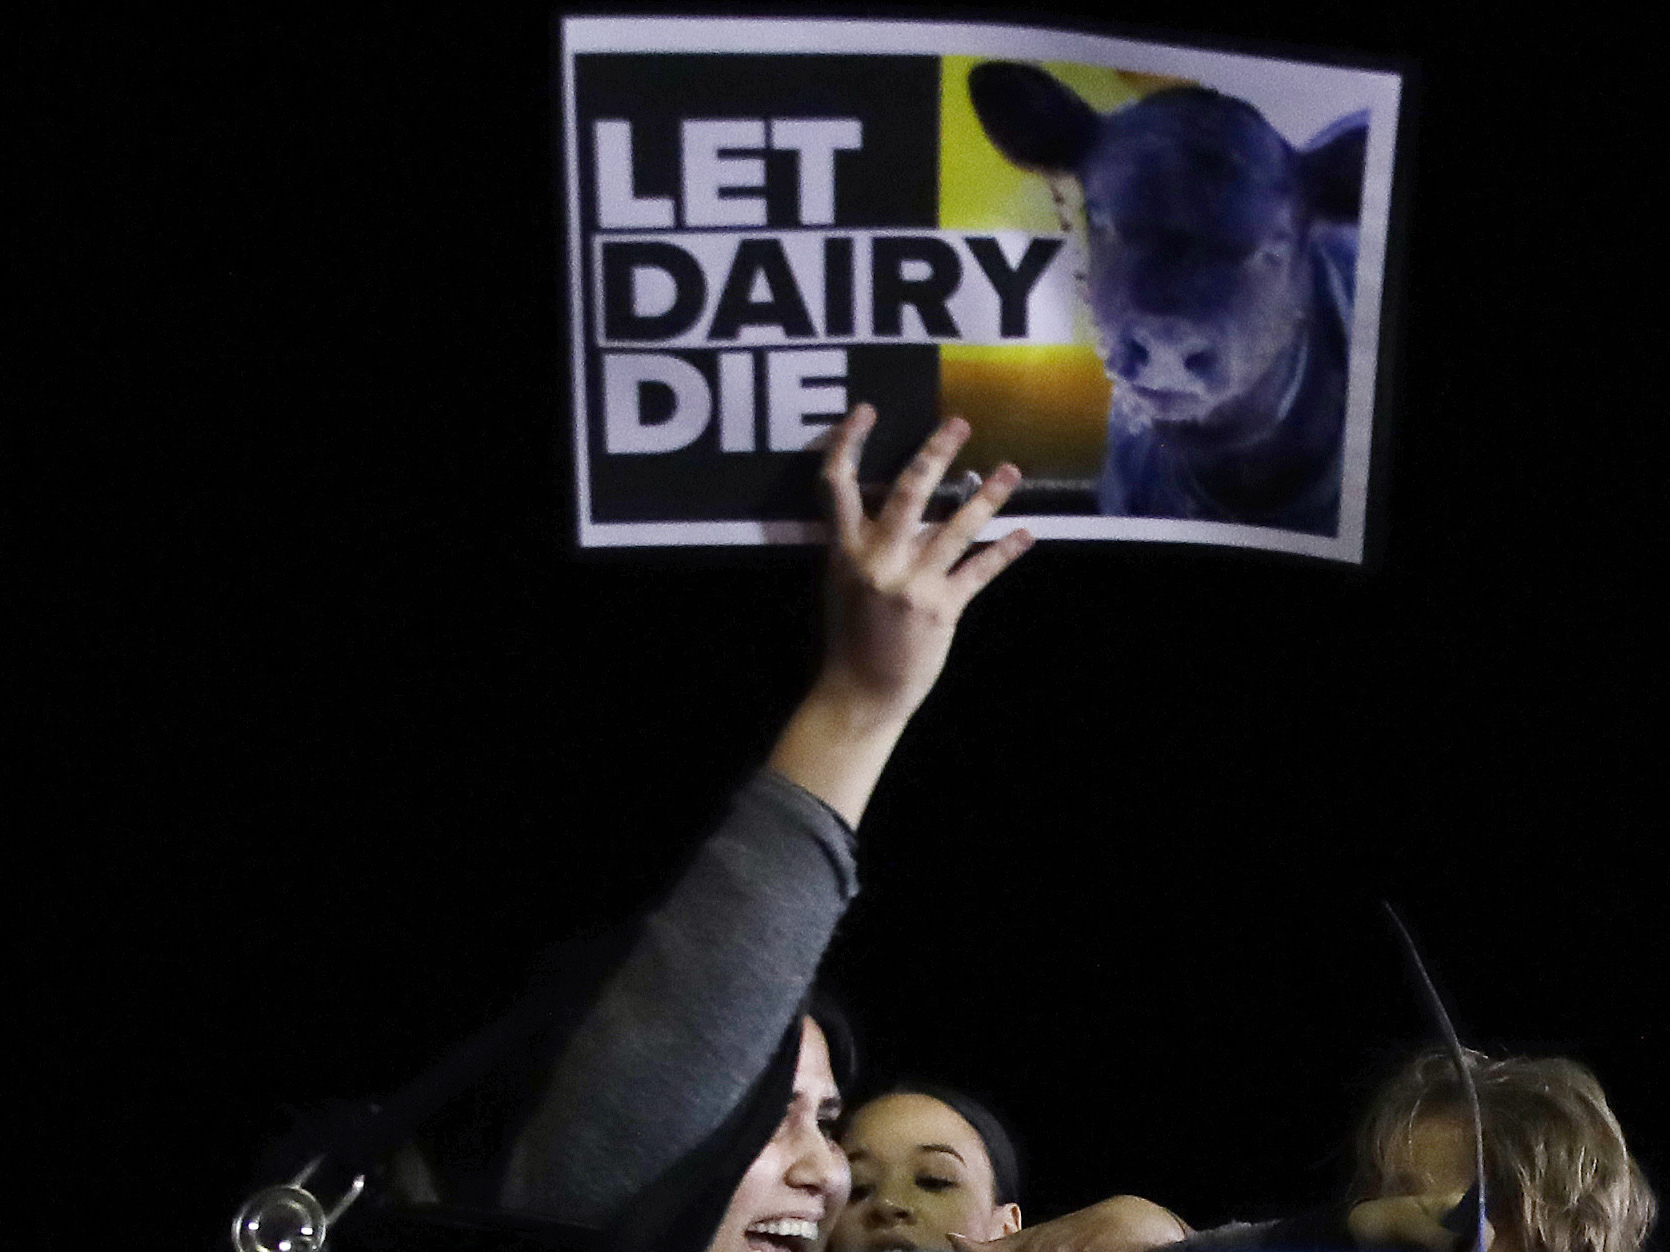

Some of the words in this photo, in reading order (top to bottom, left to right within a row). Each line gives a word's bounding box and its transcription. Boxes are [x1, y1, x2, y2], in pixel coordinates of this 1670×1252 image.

[594, 118, 863, 230] LET
[602, 236, 1066, 342] DAIRY
[603, 349, 849, 456] DIE
